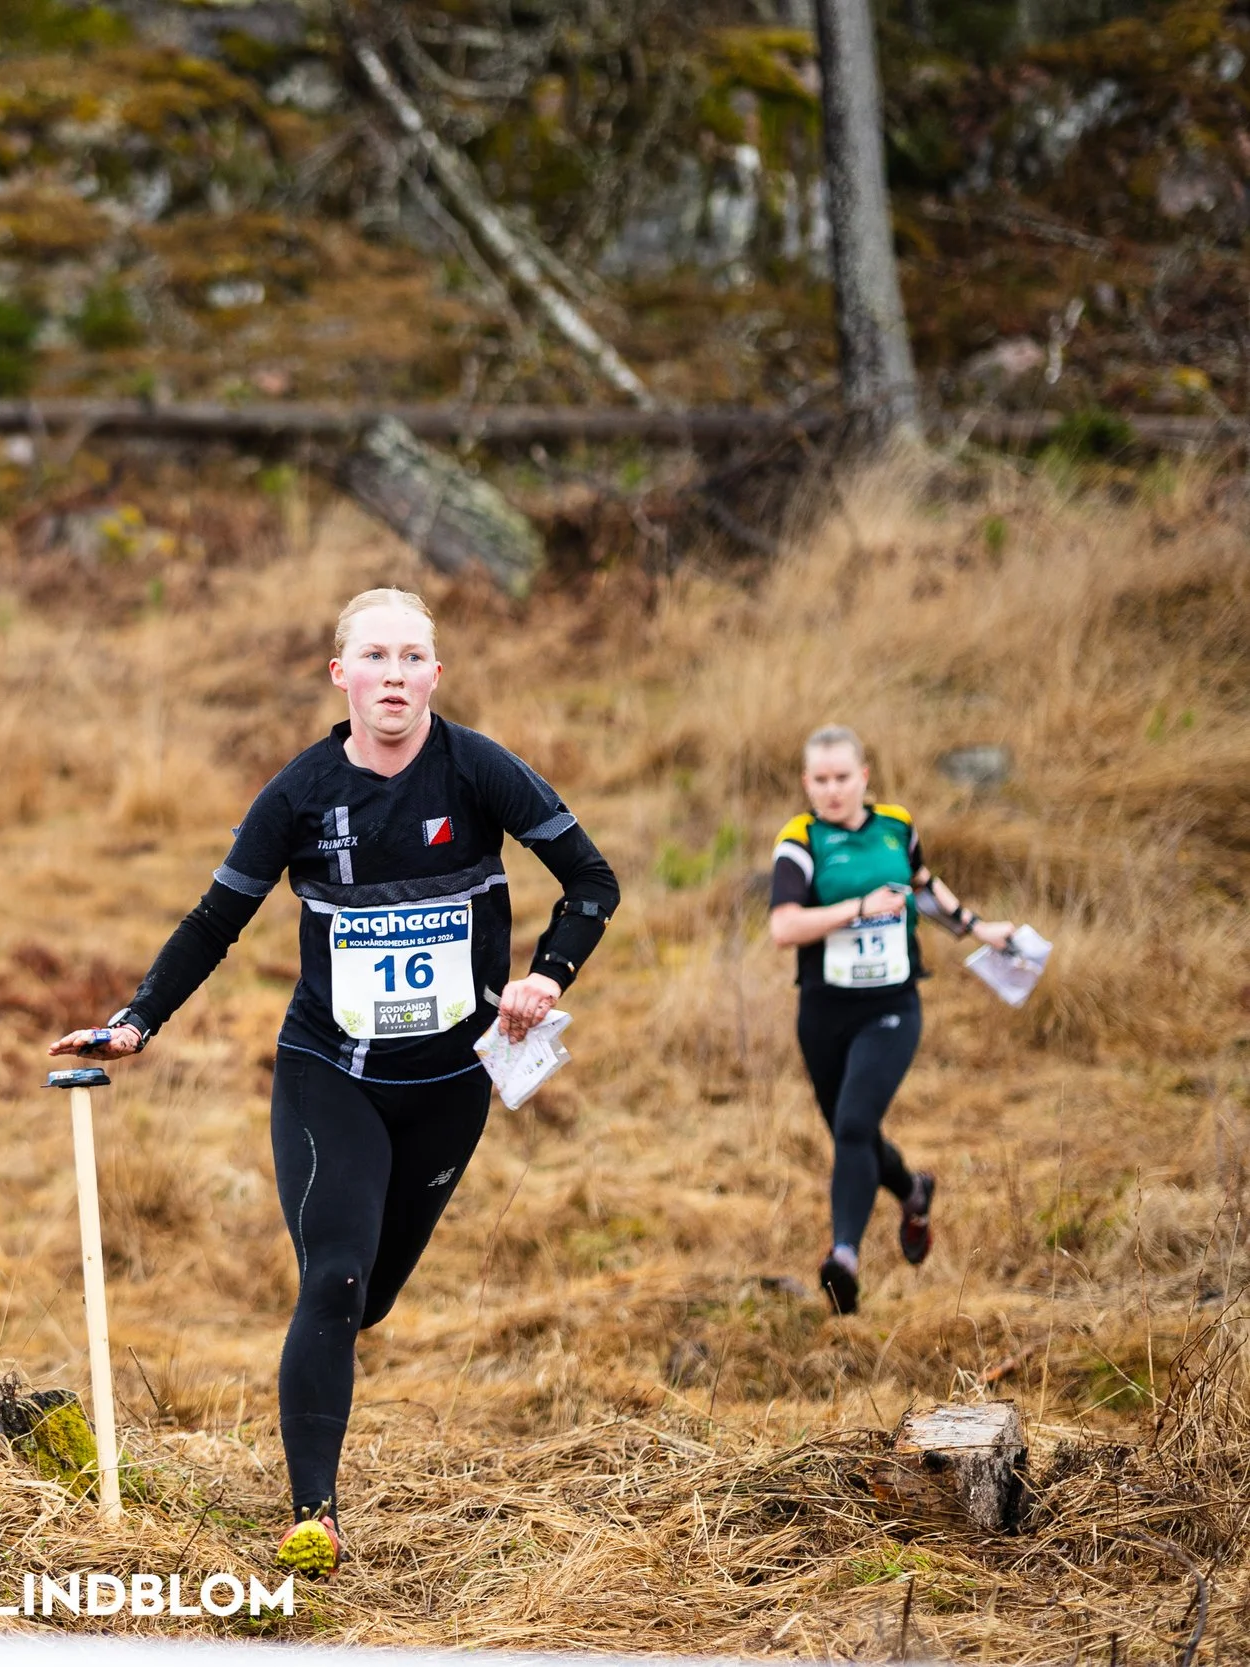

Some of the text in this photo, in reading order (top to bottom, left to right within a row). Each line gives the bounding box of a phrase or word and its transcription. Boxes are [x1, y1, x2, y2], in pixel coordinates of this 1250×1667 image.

[318, 836, 359, 850] TRIMTEX
[334, 910, 468, 936] bagheera
[350, 939, 416, 947] KOLMÅRDSMEDELN
[438, 933, 454, 942] 2026
[853, 935, 885, 956] 15
[374, 952, 434, 992] 16
[379, 1002, 431, 1013] GODKÄNDA
[379, 1009, 431, 1024] AVLOPP
